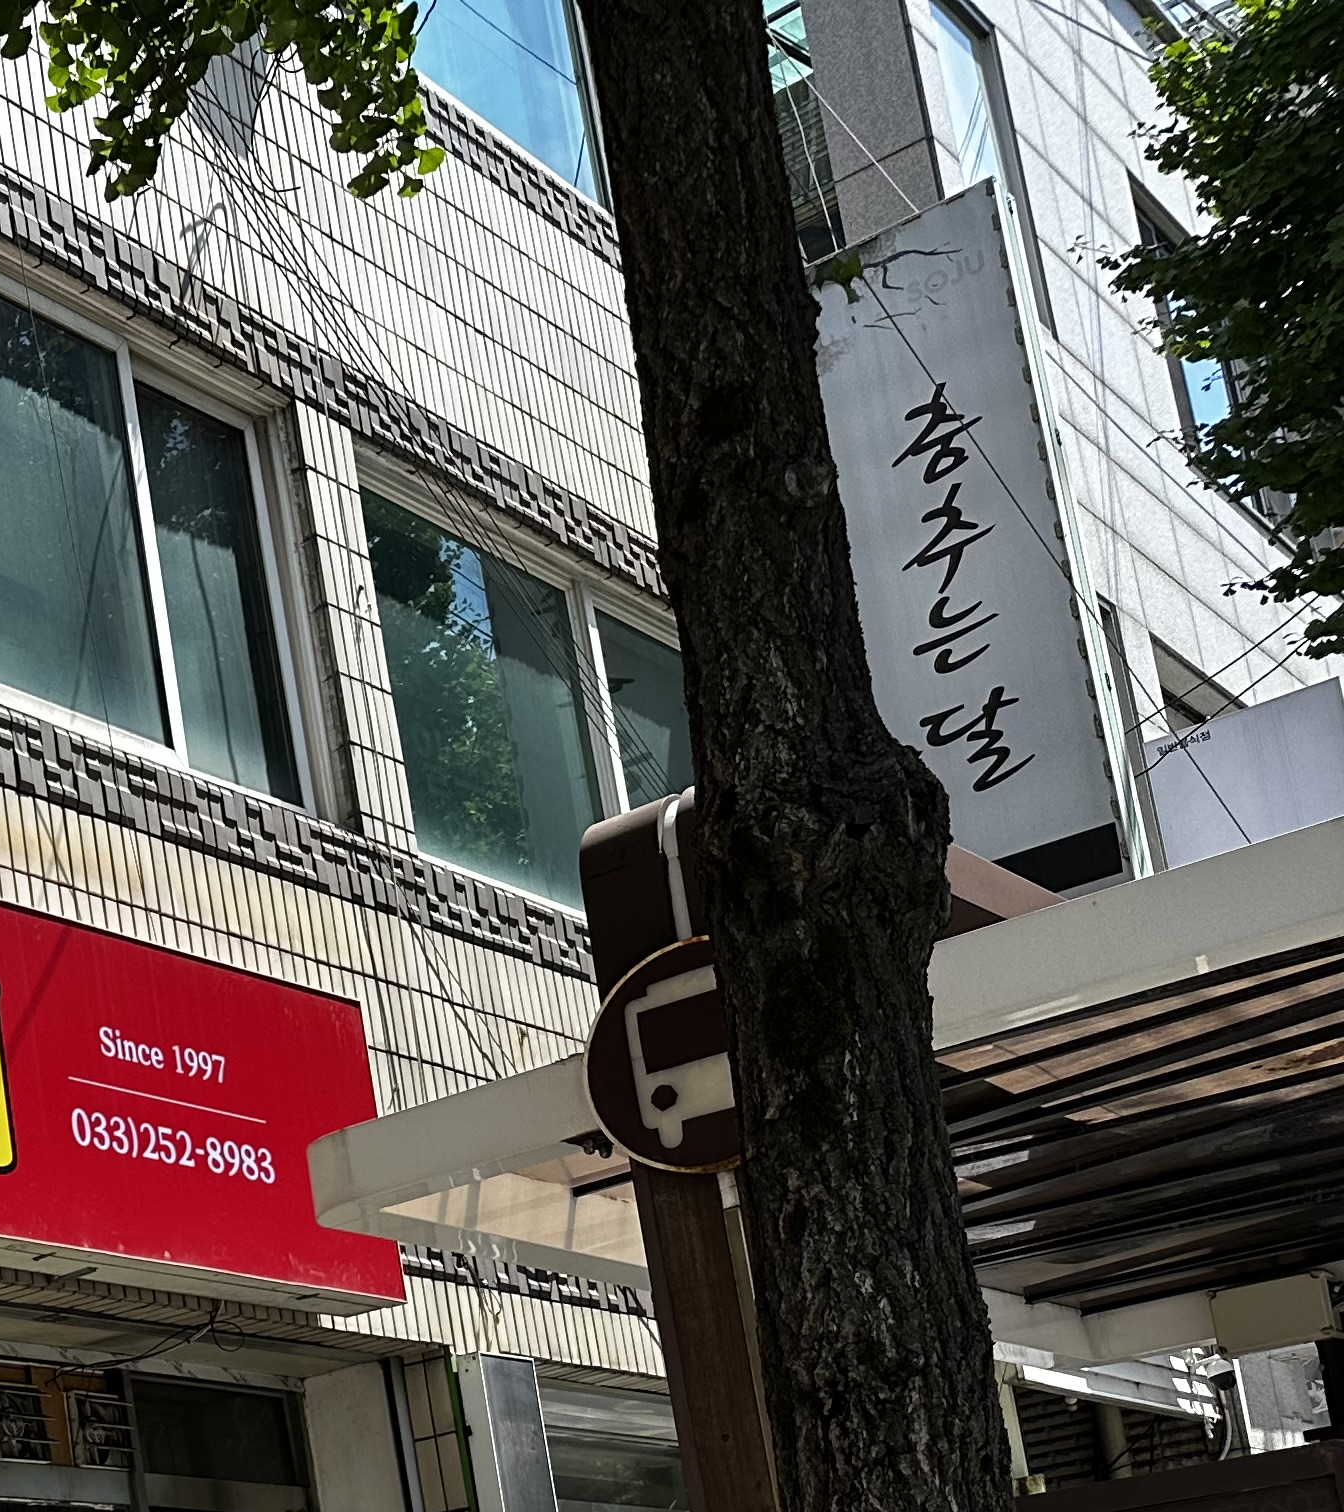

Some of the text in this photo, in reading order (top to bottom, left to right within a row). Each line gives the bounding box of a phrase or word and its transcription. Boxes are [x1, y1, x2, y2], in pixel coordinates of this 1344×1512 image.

[919, 686, 1035, 792] 달
[99, 1026, 225, 1083] Since 1997
[71, 1108, 275, 1184] 033)252-8983
